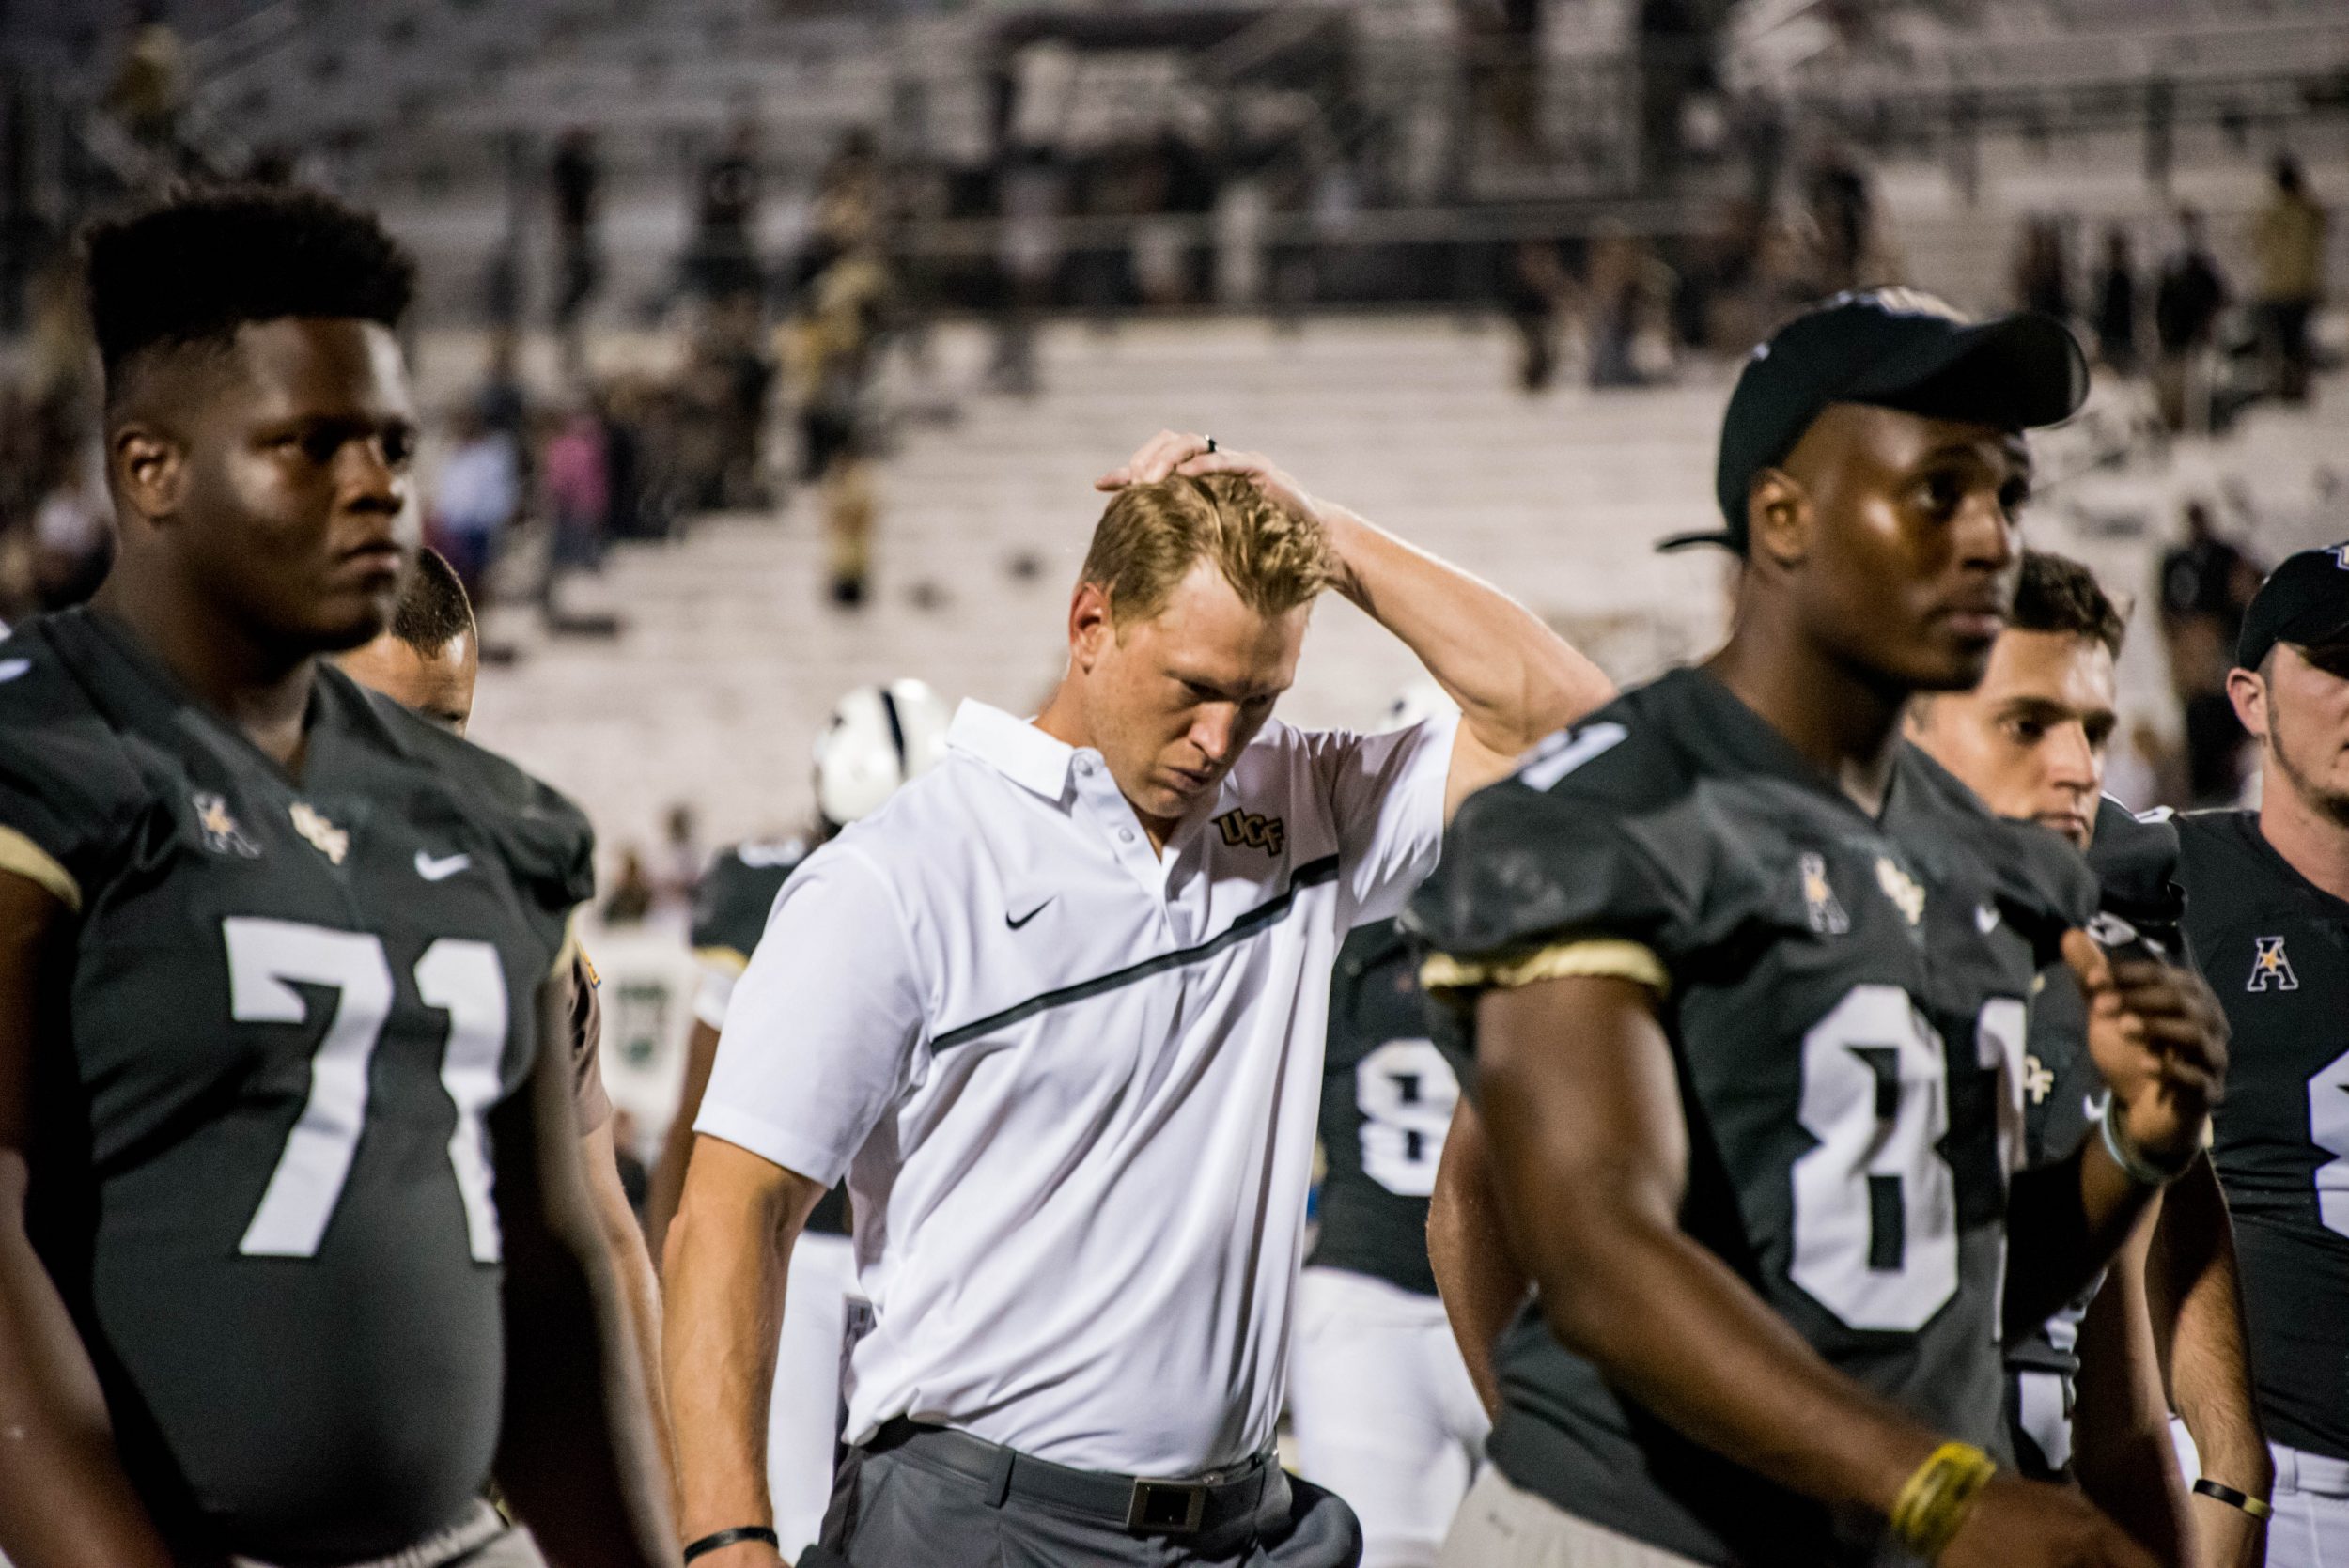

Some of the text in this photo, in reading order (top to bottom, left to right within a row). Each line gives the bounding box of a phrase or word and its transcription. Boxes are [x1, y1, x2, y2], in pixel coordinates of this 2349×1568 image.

[1210, 807, 1284, 857] UCF
[2247, 936, 2299, 992] A
[223, 916, 509, 1264] 71
[1789, 985, 2026, 1343] 81
